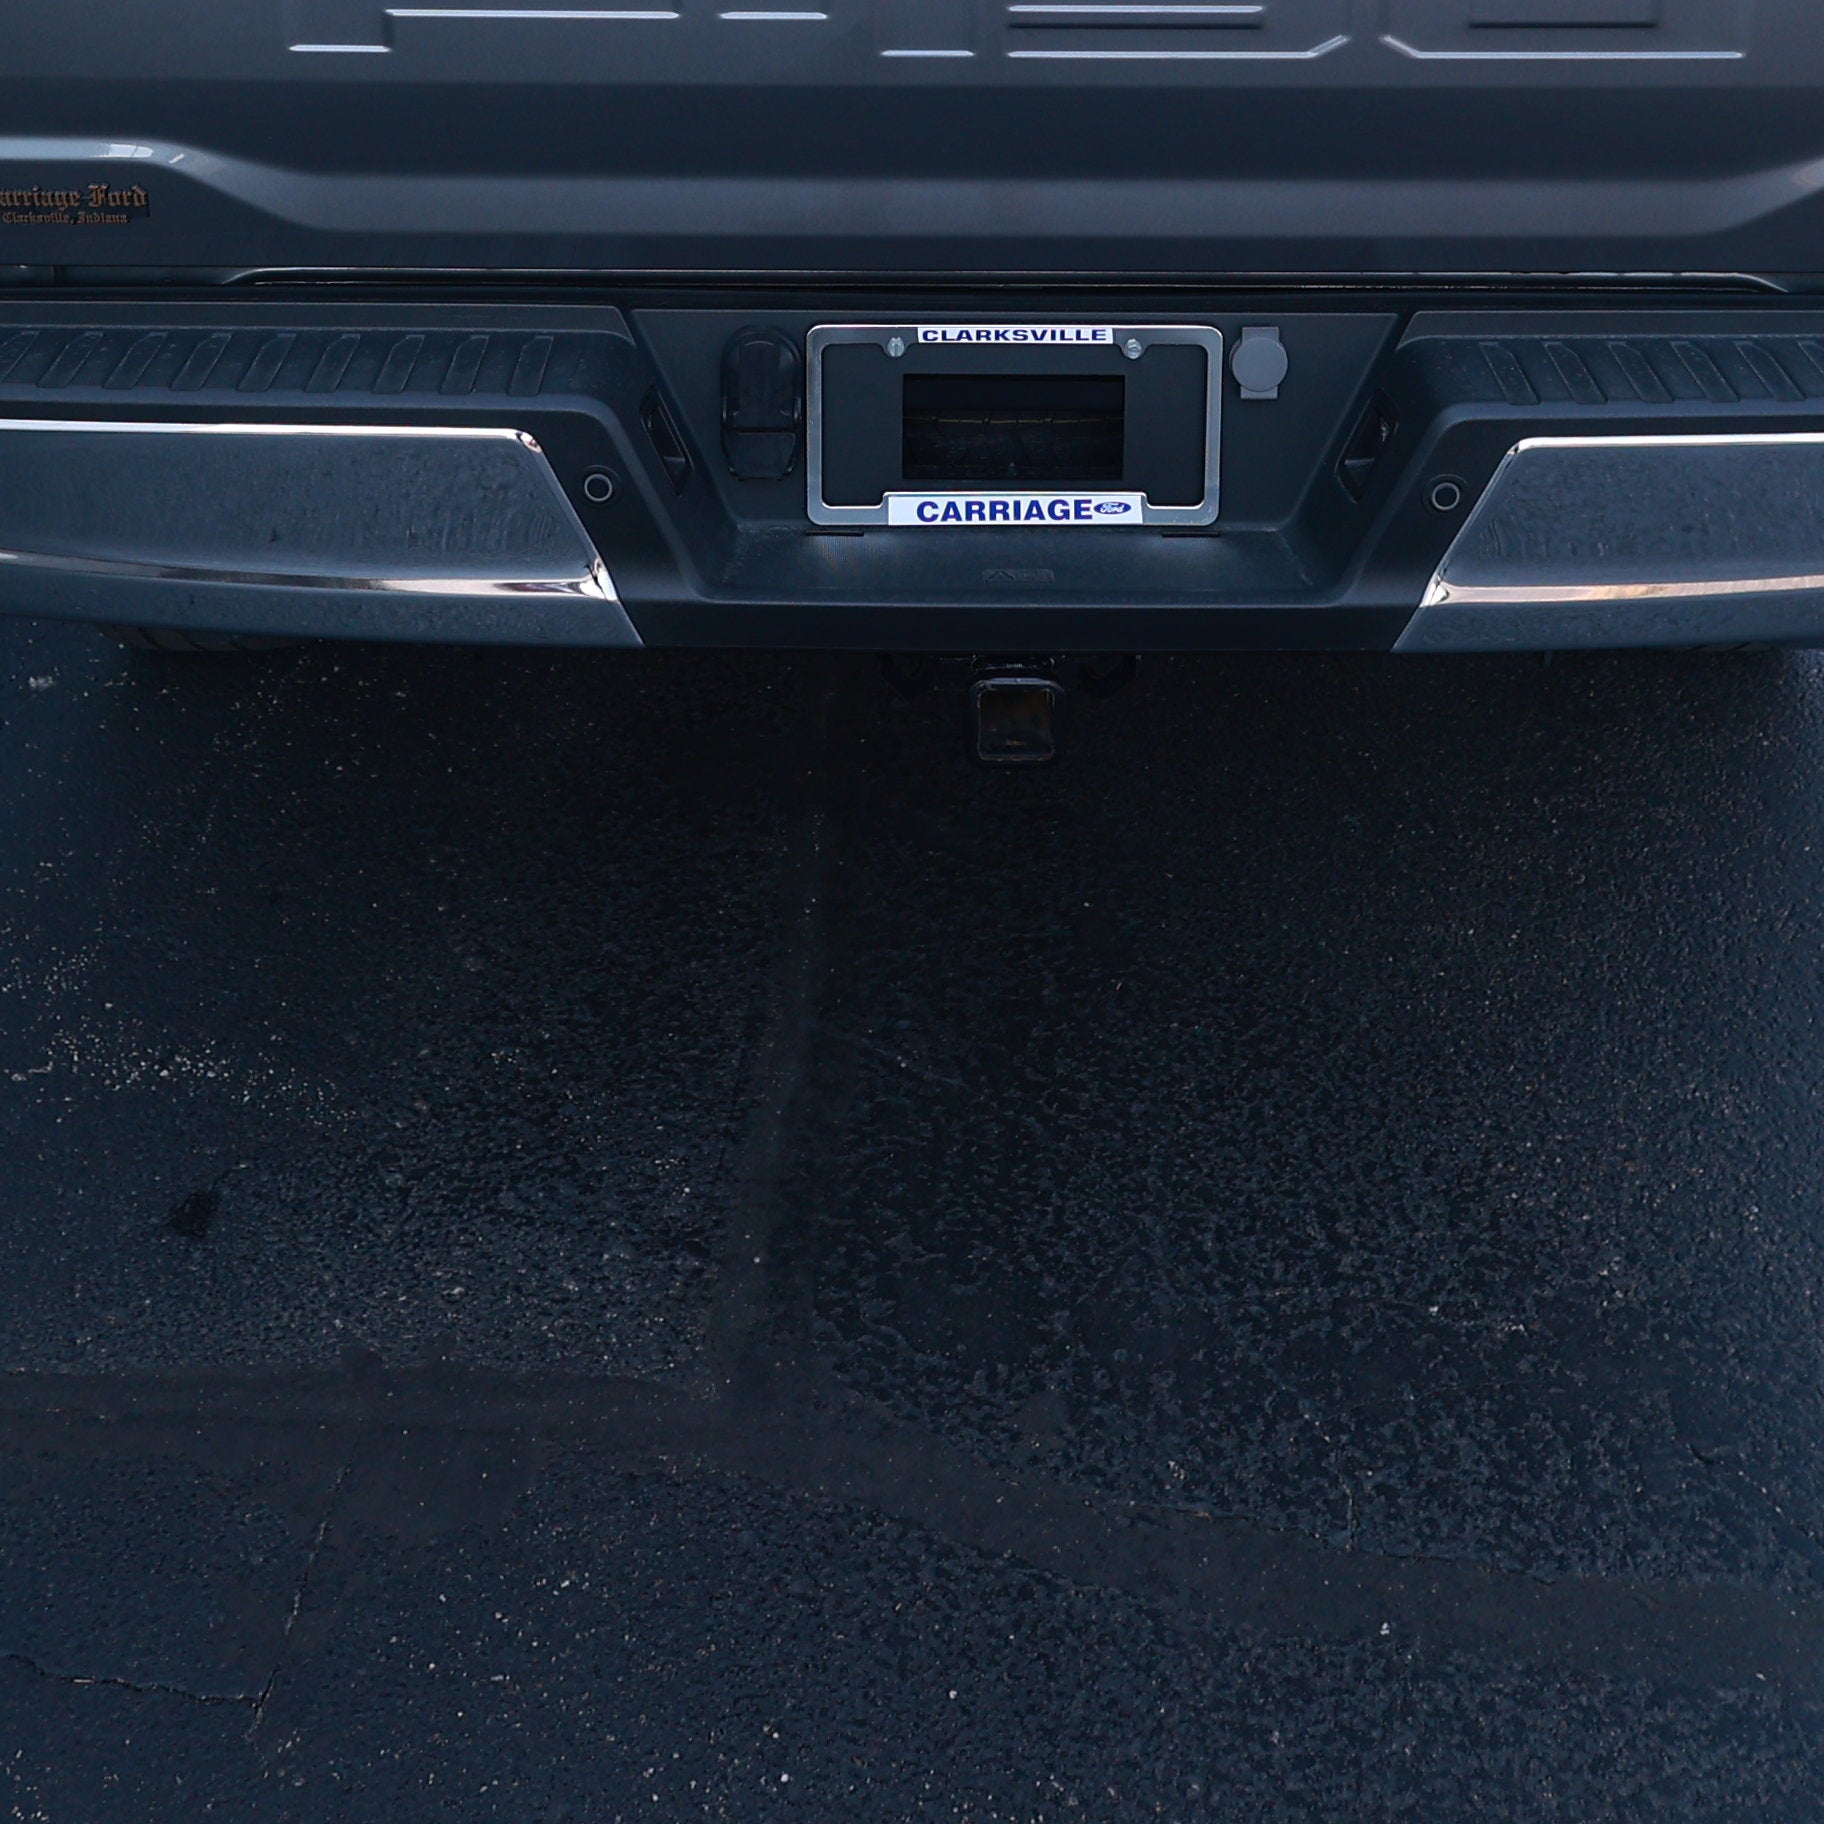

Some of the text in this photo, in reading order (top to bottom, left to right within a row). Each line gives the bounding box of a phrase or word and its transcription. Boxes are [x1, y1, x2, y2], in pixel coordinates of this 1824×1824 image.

[87, 183, 149, 208] Ford
[921, 328, 1108, 342] CLARKSVILLE
[916, 498, 1126, 523] CARRIAGE Ford
